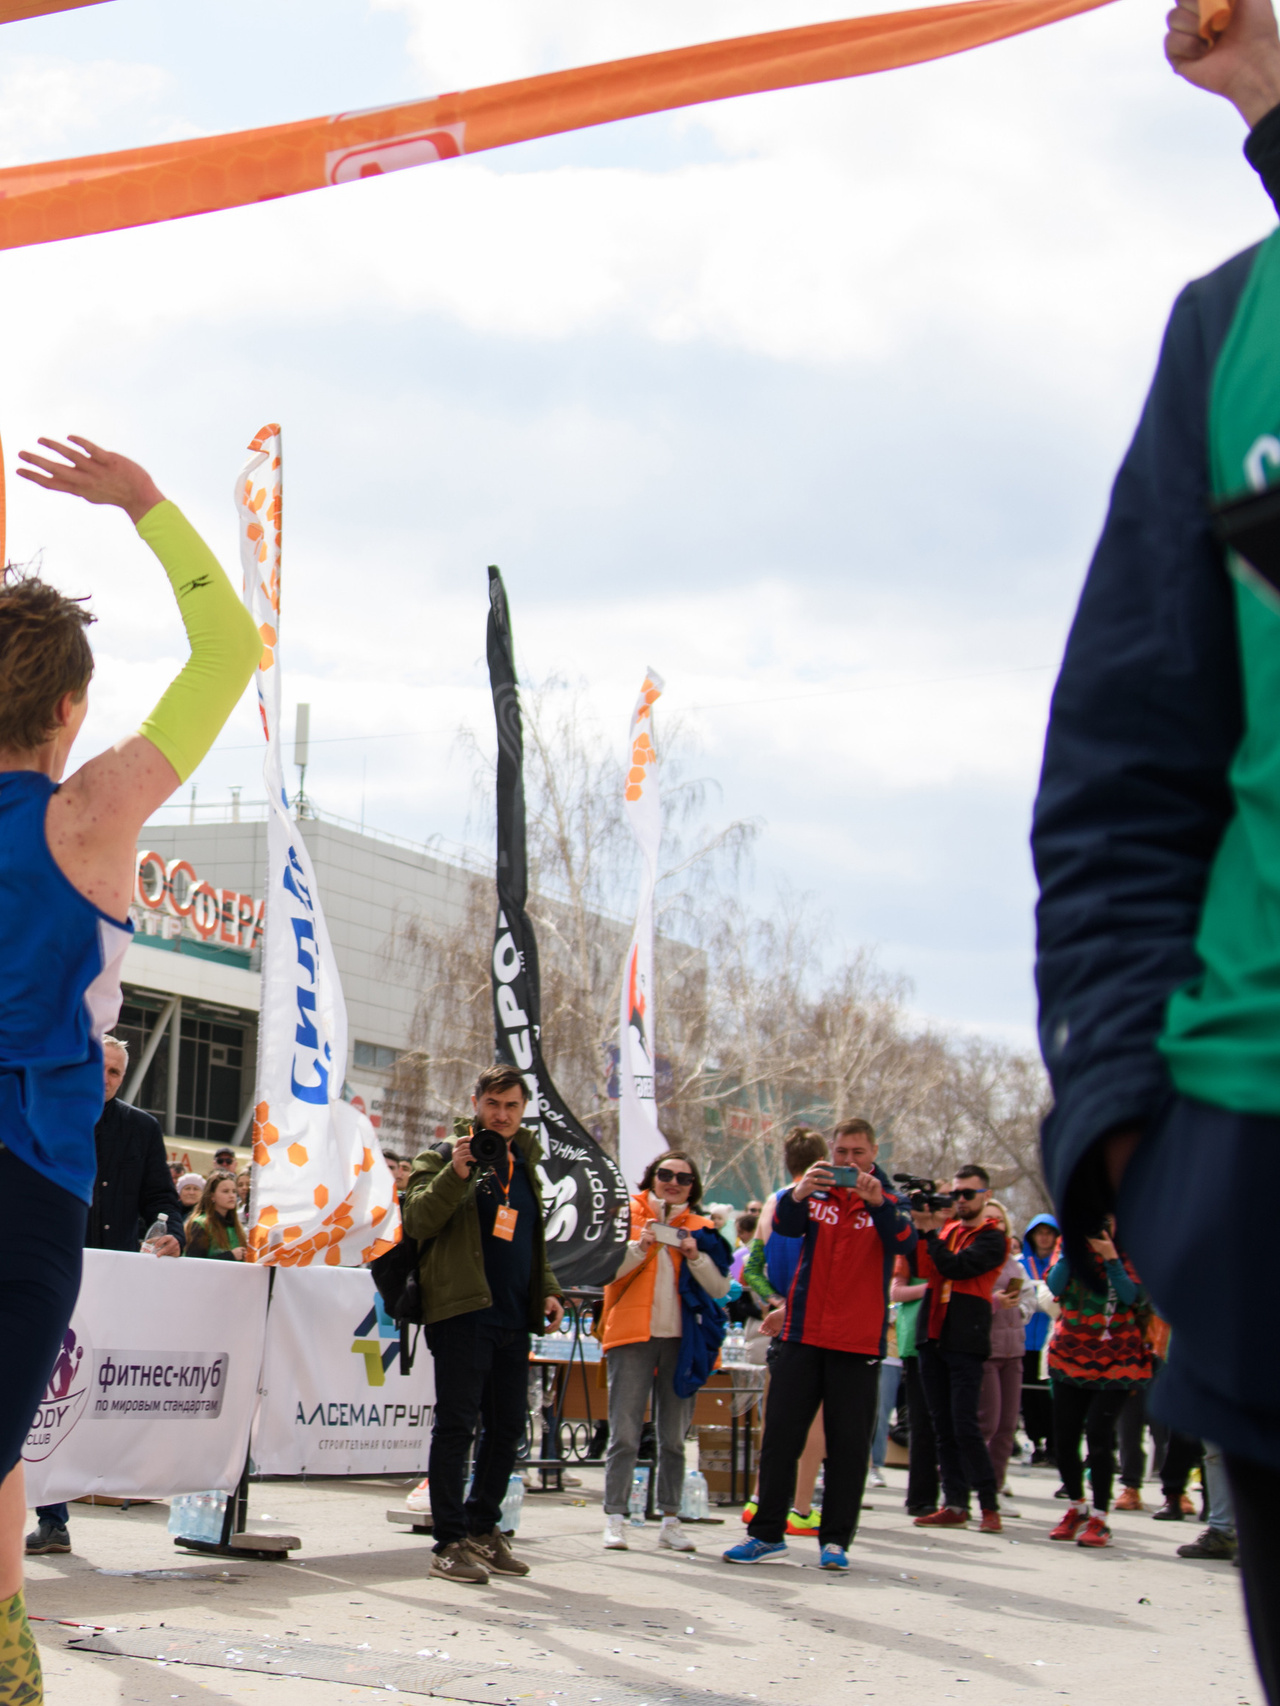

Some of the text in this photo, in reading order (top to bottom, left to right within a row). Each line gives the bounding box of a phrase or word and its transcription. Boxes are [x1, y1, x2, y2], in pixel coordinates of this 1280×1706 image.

[583, 1166, 609, 1242] Спорт
[98, 1356, 223, 1394] фитнес-клуб
[31, 1405, 70, 1429] ODY
[95, 1400, 218, 1415] по мировым стандартам
[26, 1433, 51, 1446] CLUB
[318, 1439, 423, 1450] СТРОИТЕЛЬНАЯ КОМПАНИЯ
